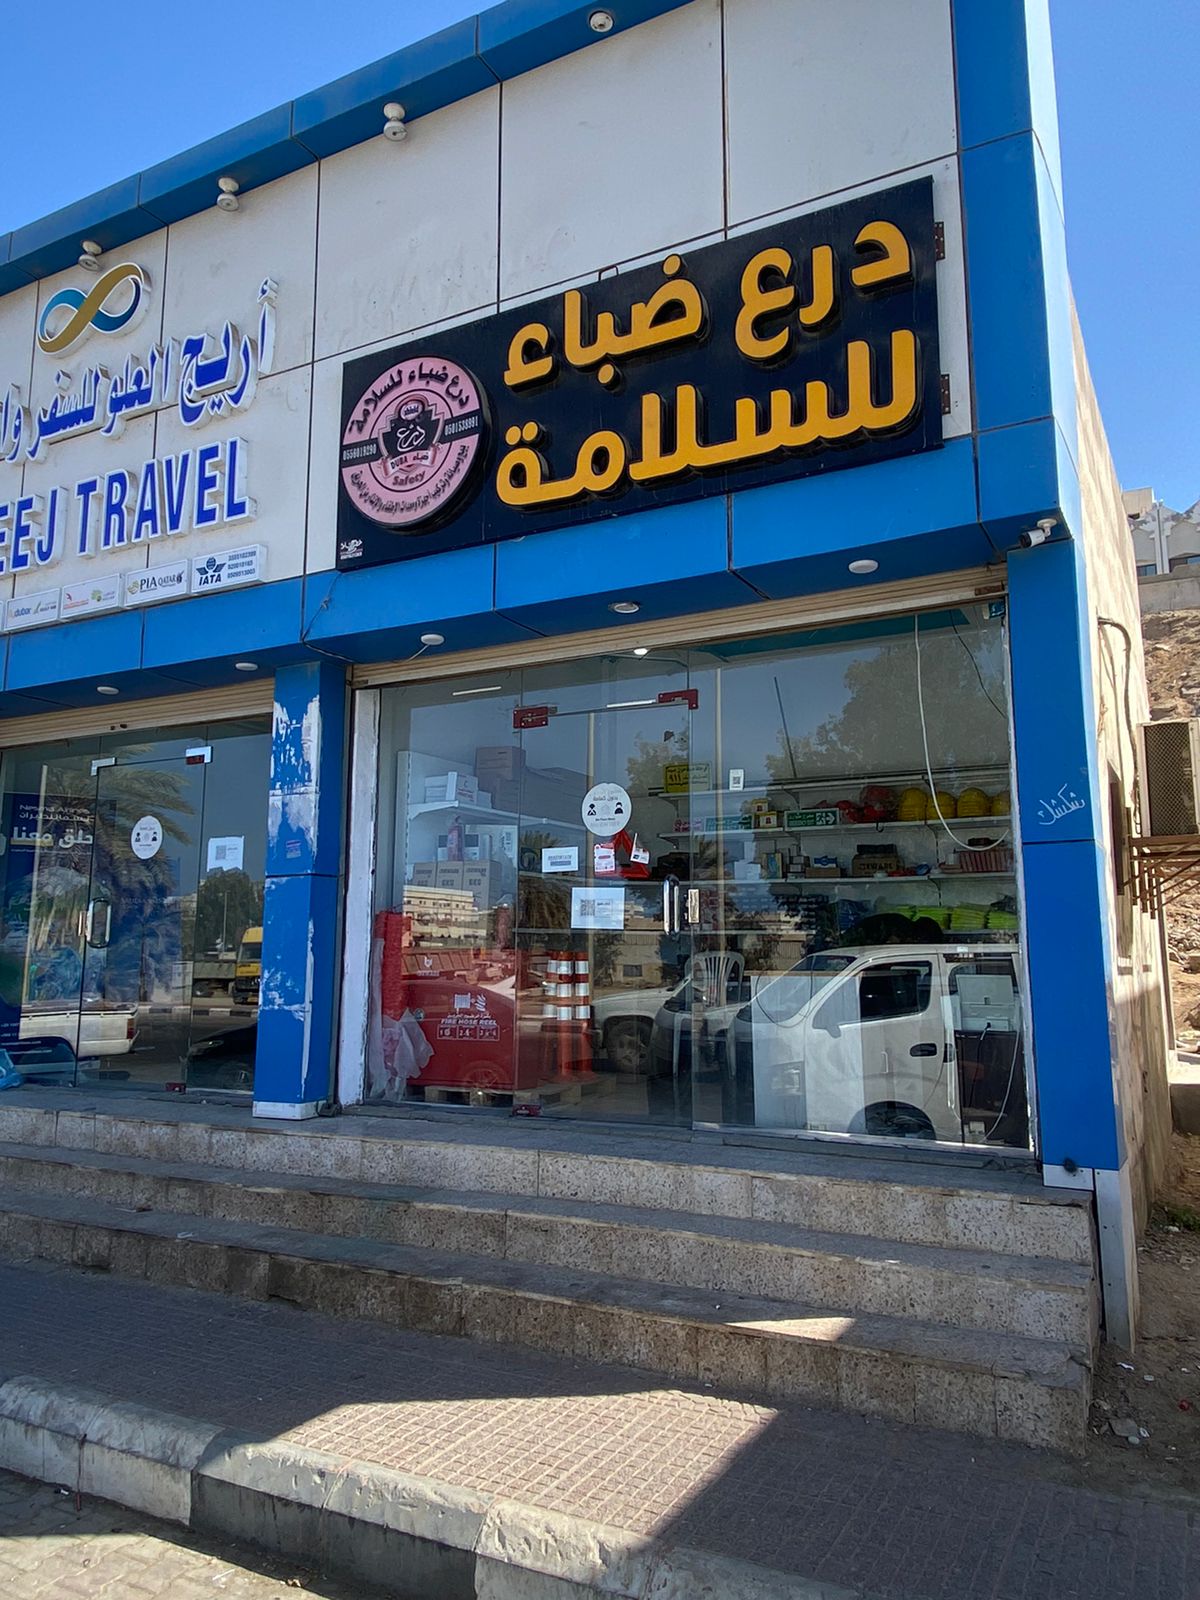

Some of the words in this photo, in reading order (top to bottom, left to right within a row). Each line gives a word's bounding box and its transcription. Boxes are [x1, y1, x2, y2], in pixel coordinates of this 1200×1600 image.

[503, 253, 703, 387] ضباء
[735, 220, 911, 360] درع
[179, 277, 276, 427] أريج
[408, 362, 449, 387] ضباء
[445, 375, 470, 408] درع
[0, 383, 23, 463] وا
[25, 363, 101, 460] للسفر
[348, 369, 403, 433] للسلامة
[495, 329, 916, 506] للسلامة
[75, 436, 249, 556] TRAVEL
[392, 470, 426, 486] Safety
[139, 576, 157, 590] PIA
[198, 574, 222, 586] IATA
